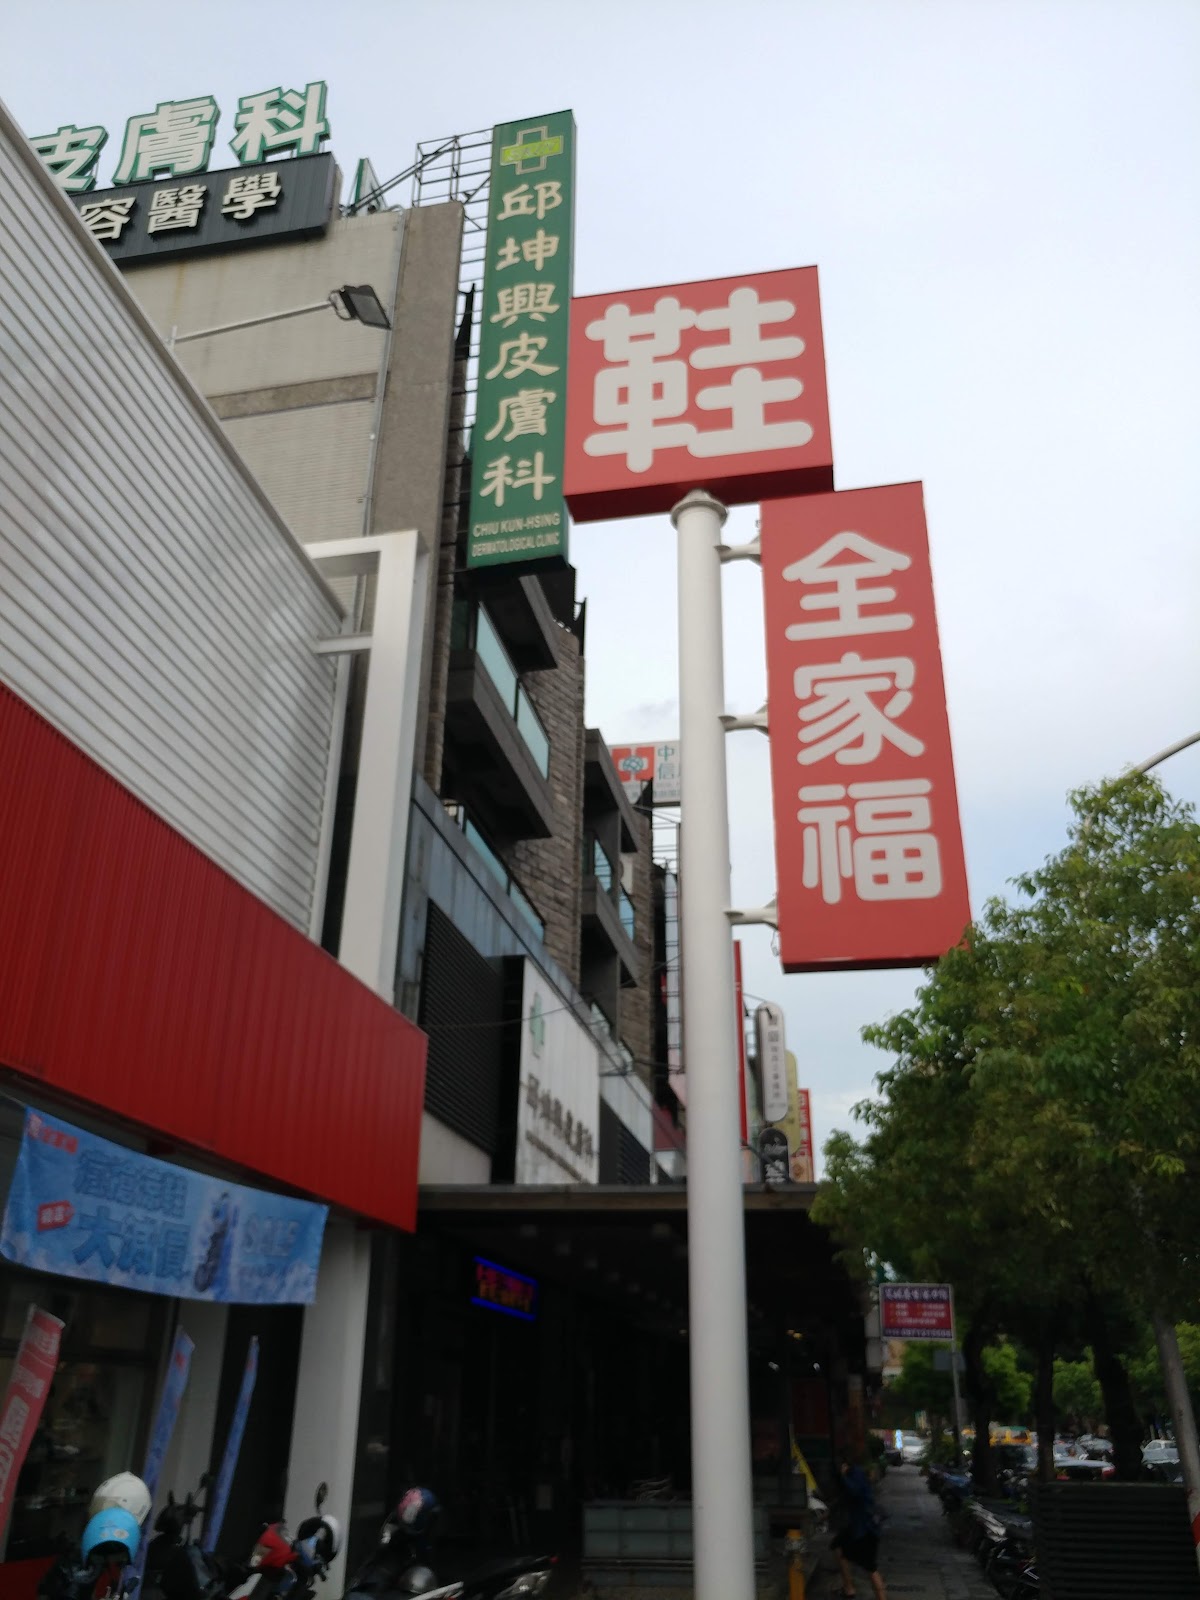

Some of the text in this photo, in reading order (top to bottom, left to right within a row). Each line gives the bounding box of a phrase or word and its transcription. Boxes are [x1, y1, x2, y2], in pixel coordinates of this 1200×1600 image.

[28, 80, 331, 192] 皮膚科
[80, 171, 282, 241] 容醫學
[480, 180, 564, 508] 邱坤興皮膚科
[582, 286, 814, 474] 鞋
[473, 512, 560, 537] CHIU KUN-HSING
[781, 531, 943, 905] 全家福
